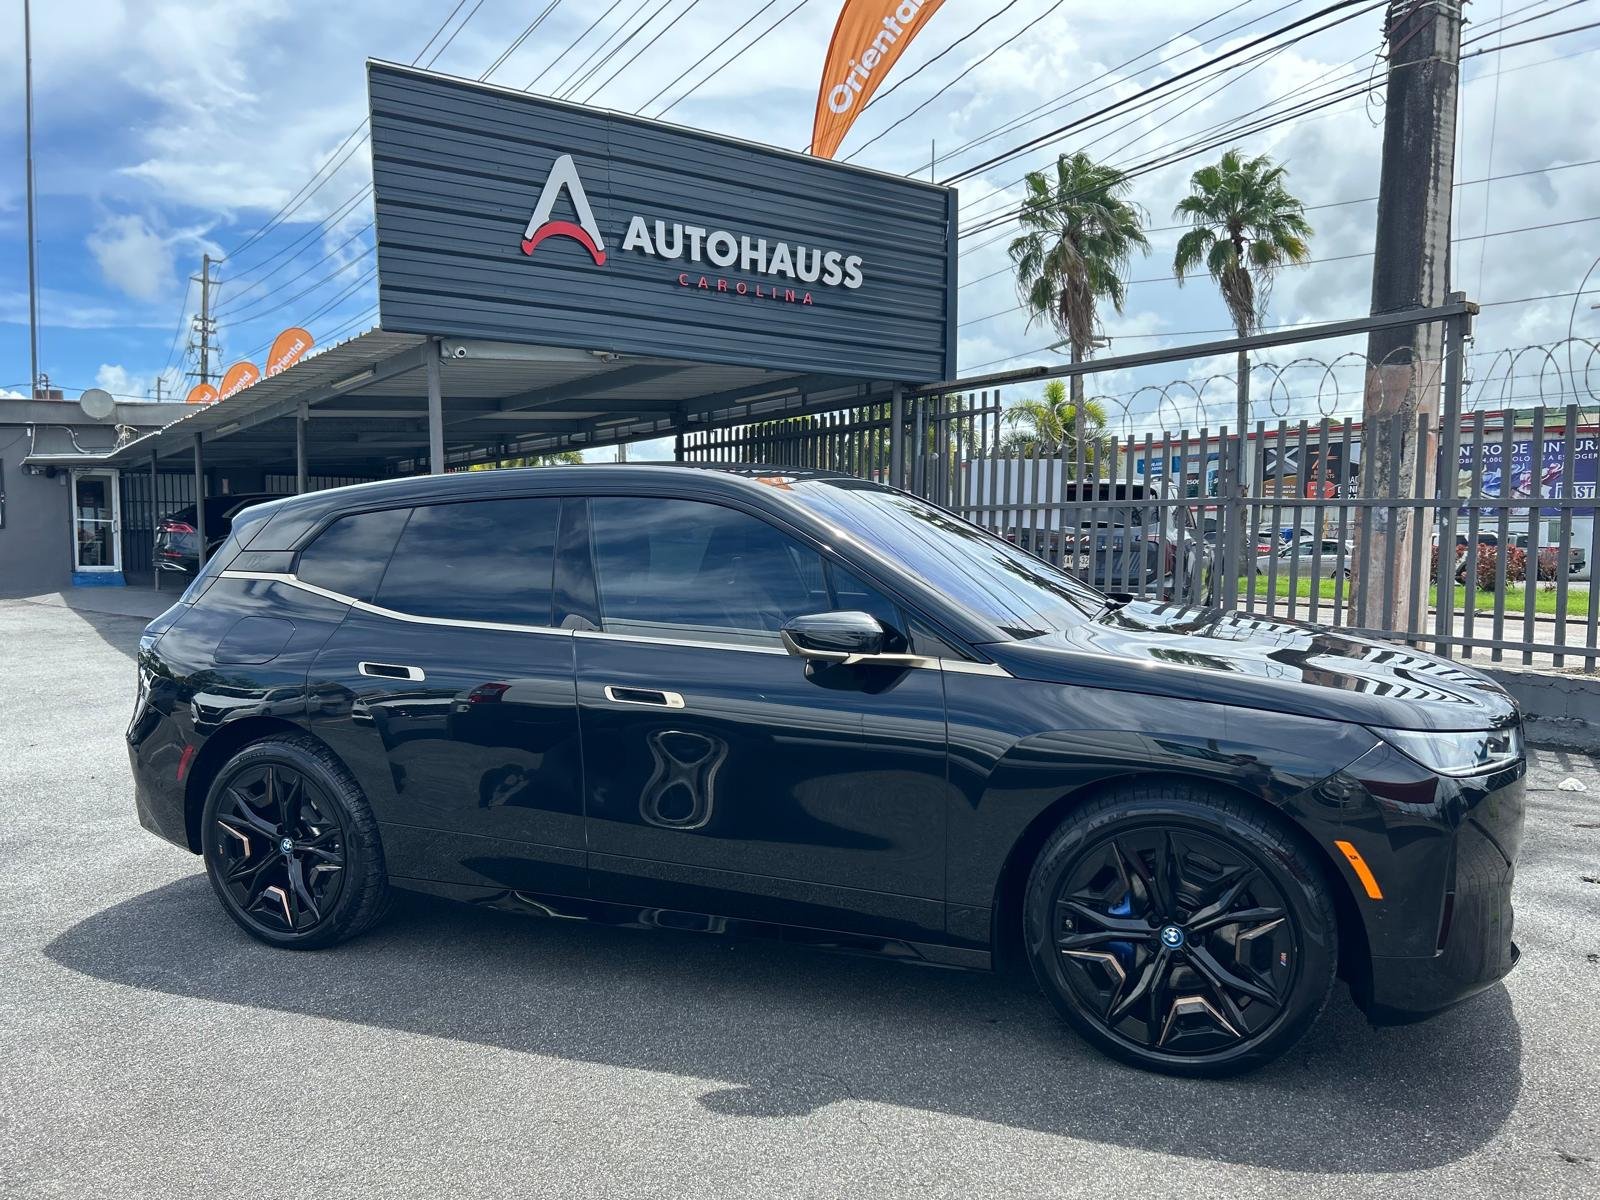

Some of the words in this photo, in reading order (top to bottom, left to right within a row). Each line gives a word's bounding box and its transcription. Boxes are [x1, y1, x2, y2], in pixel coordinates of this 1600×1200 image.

[622, 215, 864, 289] AUTOHAUSS
[678, 273, 814, 305] CAROLINA
[270, 338, 306, 375] Oriental
